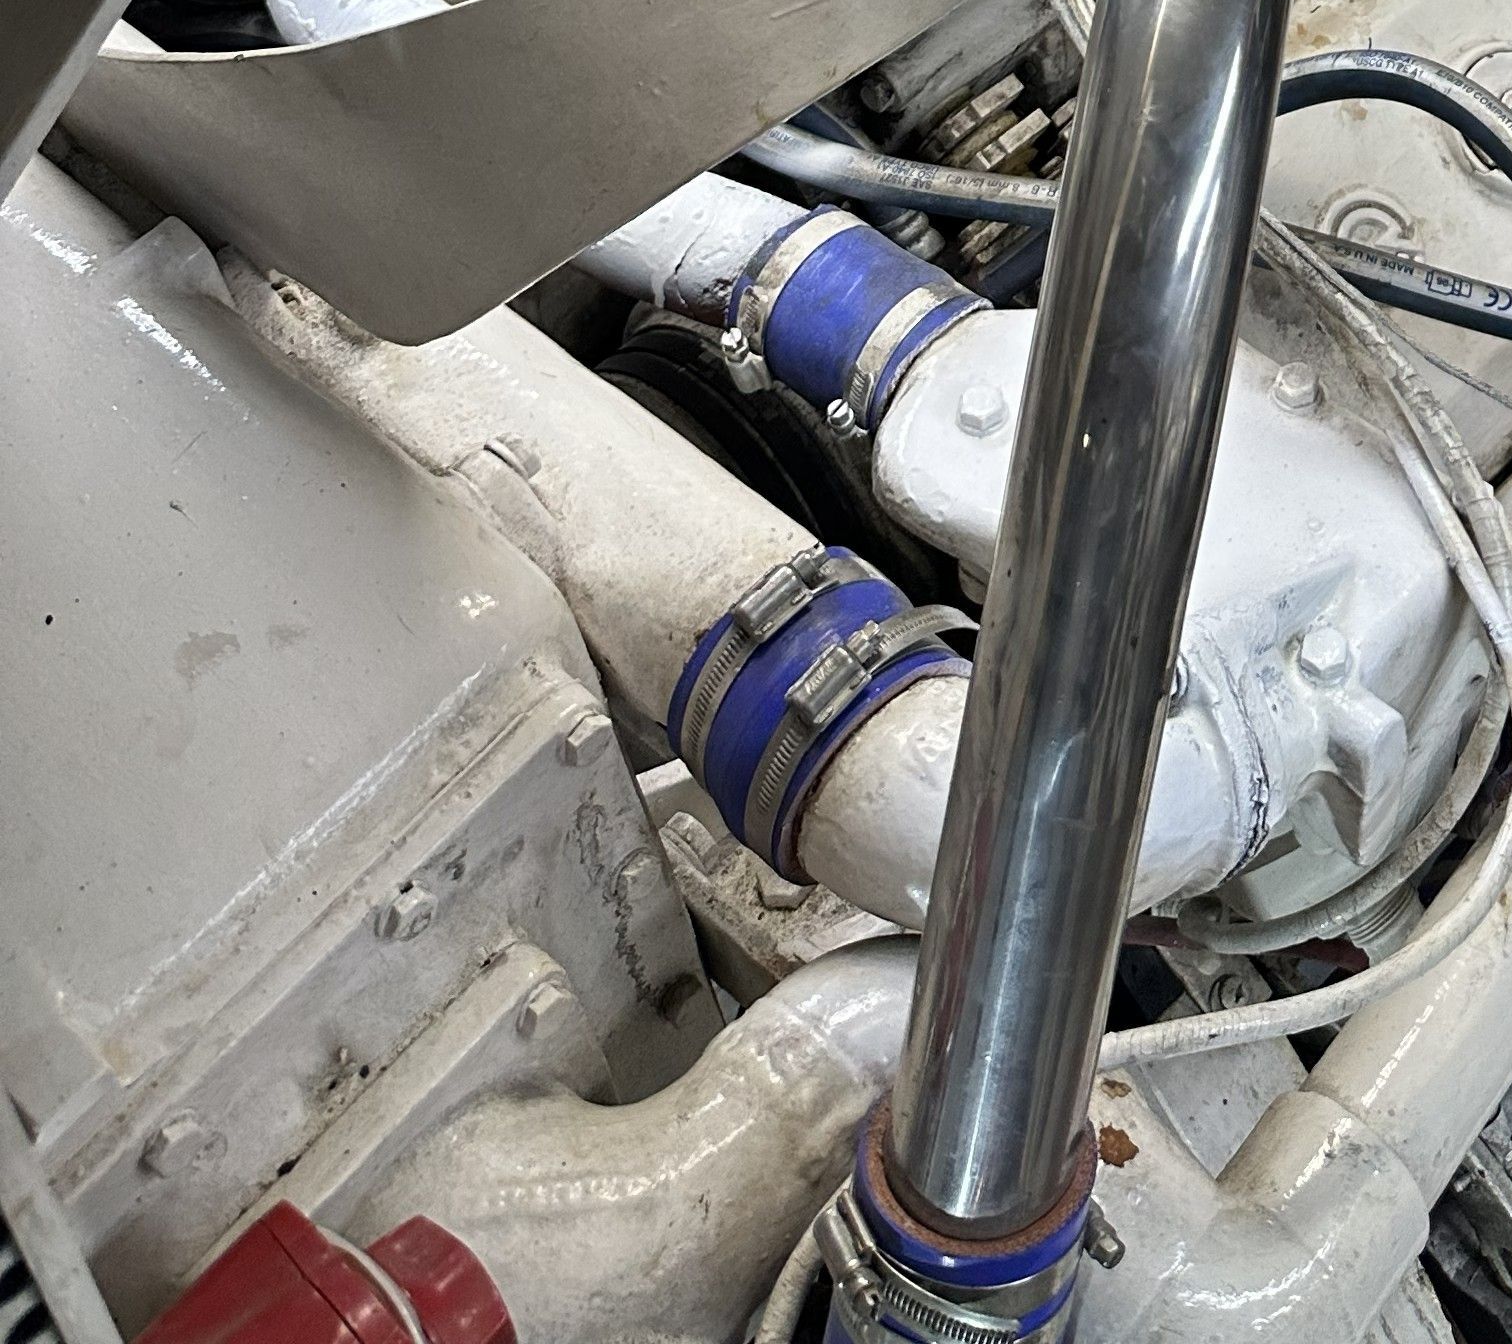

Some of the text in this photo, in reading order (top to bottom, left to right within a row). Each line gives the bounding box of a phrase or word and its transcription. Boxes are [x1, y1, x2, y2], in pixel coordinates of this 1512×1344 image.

[916, 168, 938, 180] ISO
[911, 178, 934, 190] SAE
[1380, 259, 1415, 278] MADE
